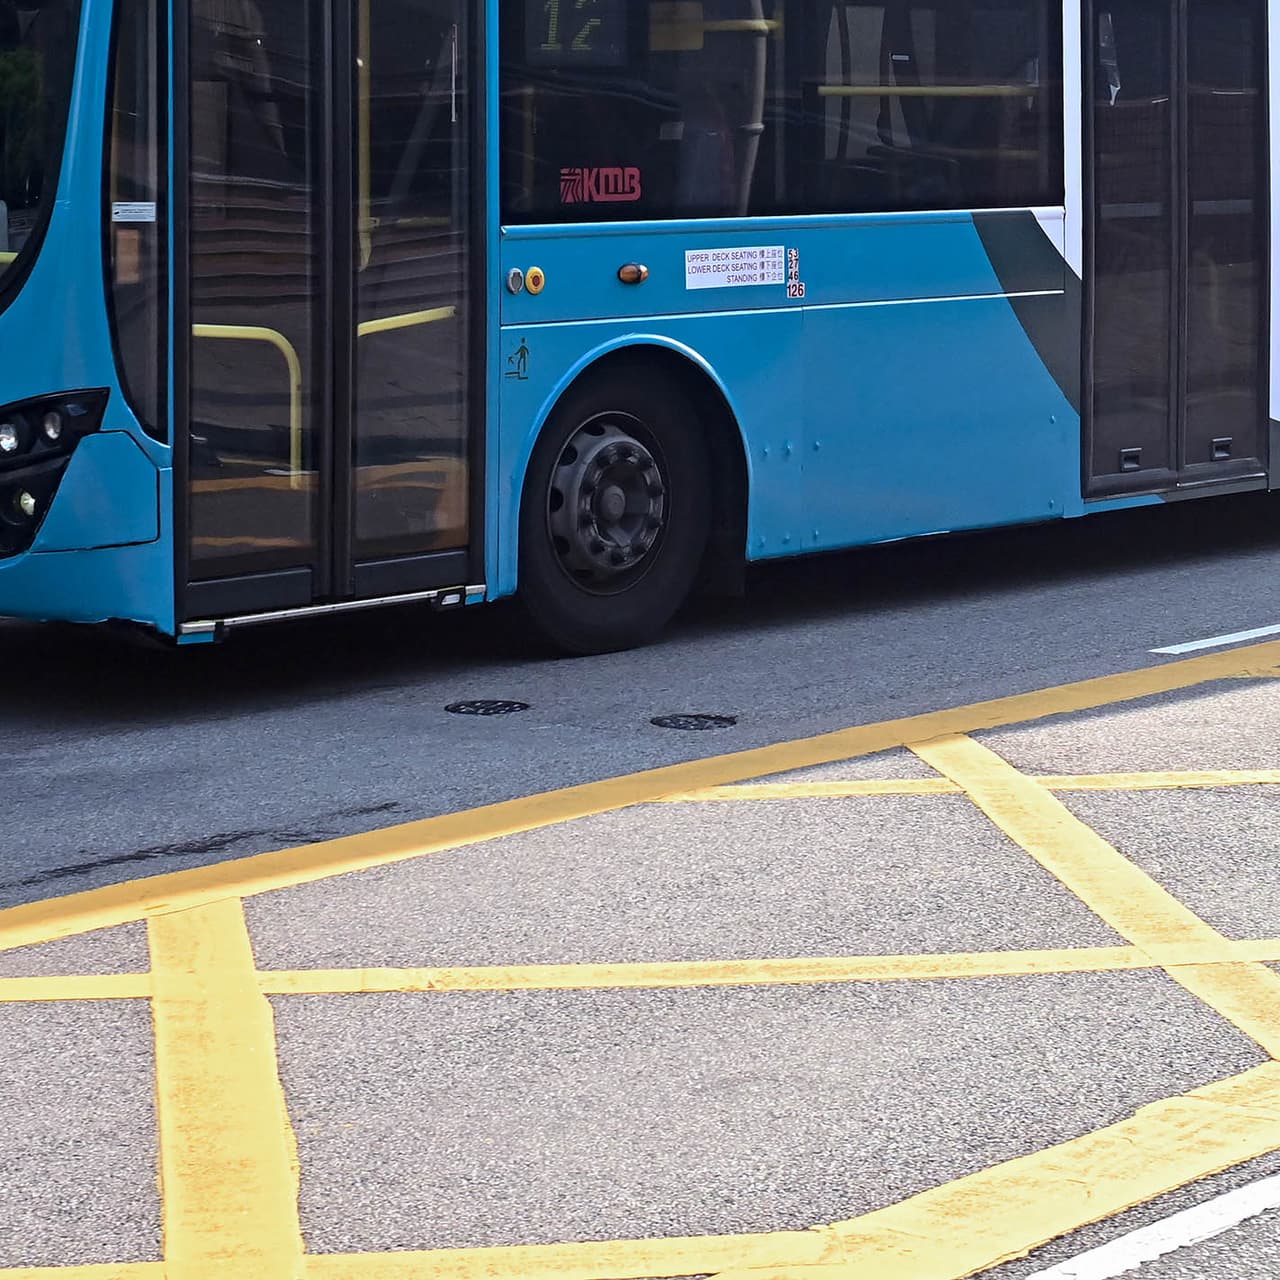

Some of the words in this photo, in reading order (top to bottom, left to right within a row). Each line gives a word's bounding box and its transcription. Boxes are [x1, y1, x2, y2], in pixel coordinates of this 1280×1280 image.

[583, 167, 642, 202] KMB
[687, 254, 709, 263] UPPER
[712, 251, 730, 261] DECK
[731, 250, 758, 260] SEATING
[688, 264, 712, 275] LOWER
[712, 263, 730, 273] DECK
[731, 261, 758, 271] SEATING
[726, 272, 758, 283] STANDING
[788, 271, 799, 281] 46
[787, 283, 804, 297] 126
